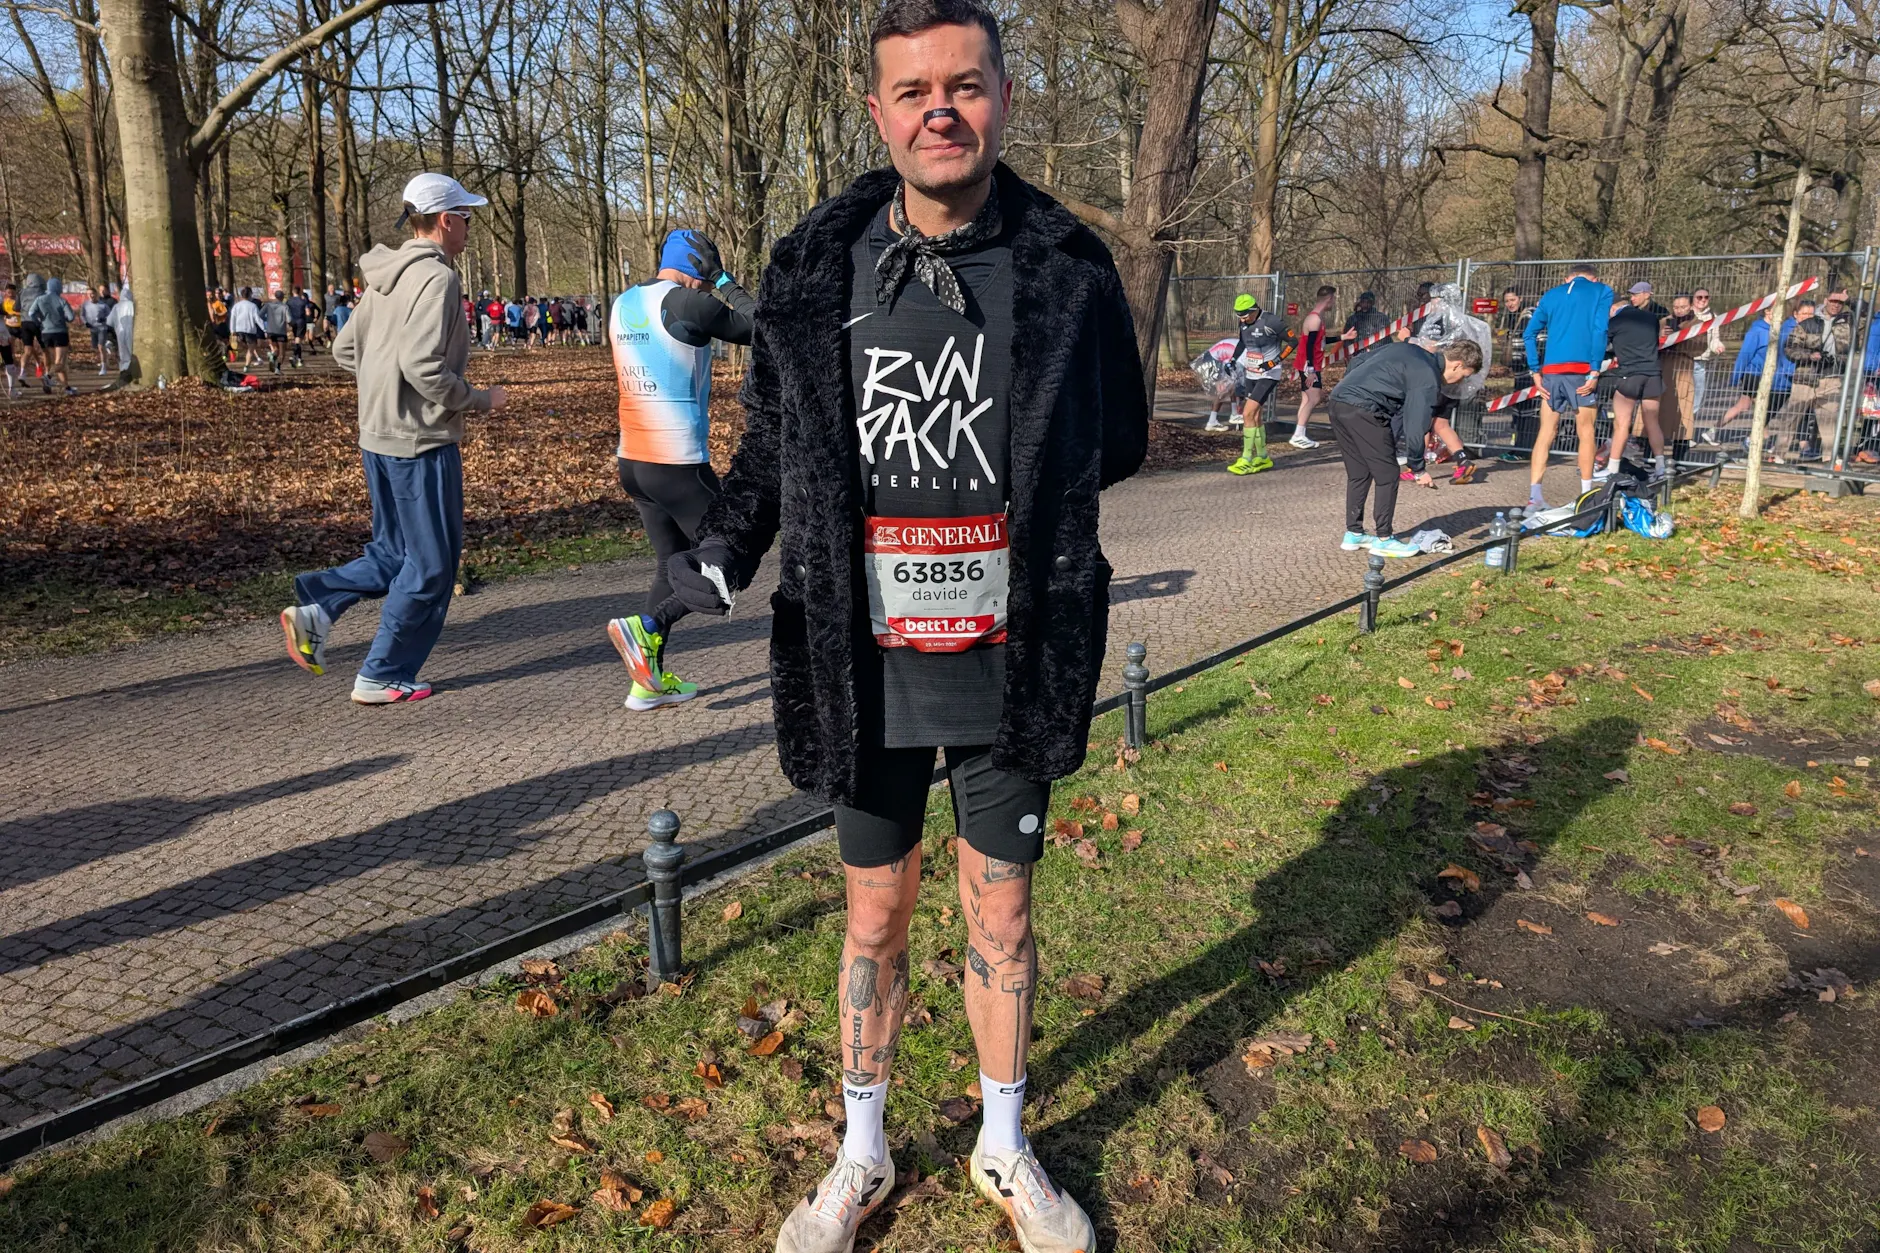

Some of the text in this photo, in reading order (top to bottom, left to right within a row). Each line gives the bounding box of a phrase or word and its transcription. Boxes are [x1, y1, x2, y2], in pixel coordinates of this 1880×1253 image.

[616, 333, 650, 341] PAPAPIETRO
[621, 365, 652, 379] ARTE
[856, 397, 997, 485] PACK
[871, 474, 979, 492] BERLIN
[901, 523, 1002, 547] GENERALI
[893, 559, 985, 584] 63836
[912, 586, 968, 601] davide
[905, 618, 977, 633] bett1.de
